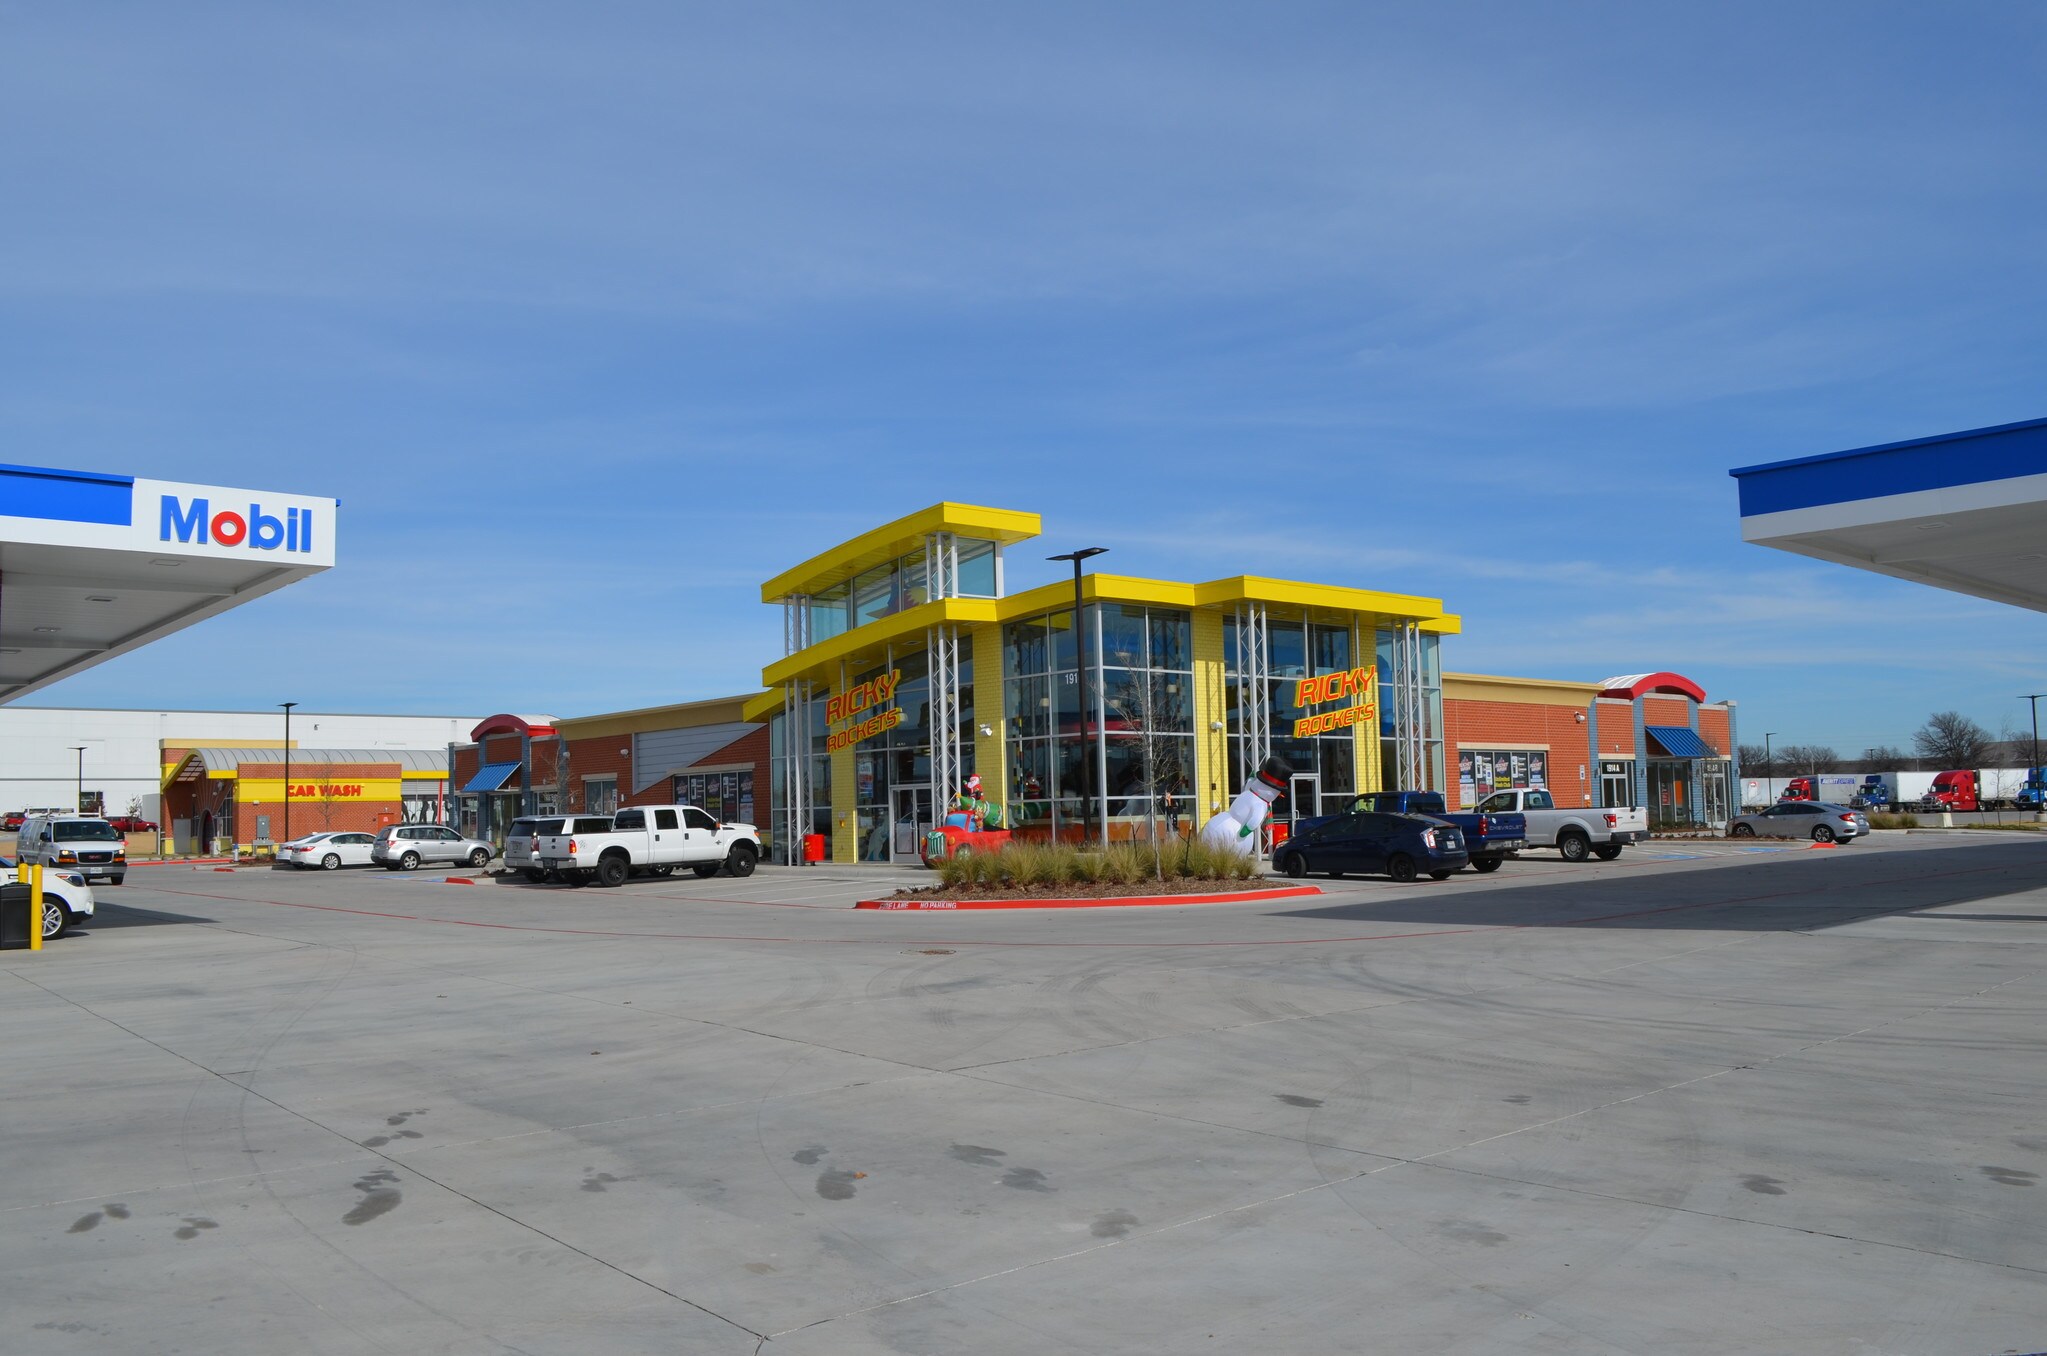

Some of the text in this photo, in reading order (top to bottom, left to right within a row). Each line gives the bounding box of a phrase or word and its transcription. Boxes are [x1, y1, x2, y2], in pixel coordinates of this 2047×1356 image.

[160, 494, 312, 553] Mobil
[825, 669, 900, 726] RICKY
[1293, 665, 1376, 708] RICKY
[826, 707, 902, 754] ROCKETS
[1293, 703, 1375, 738] ROCKETS
[288, 785, 361, 797] CAR WASH
